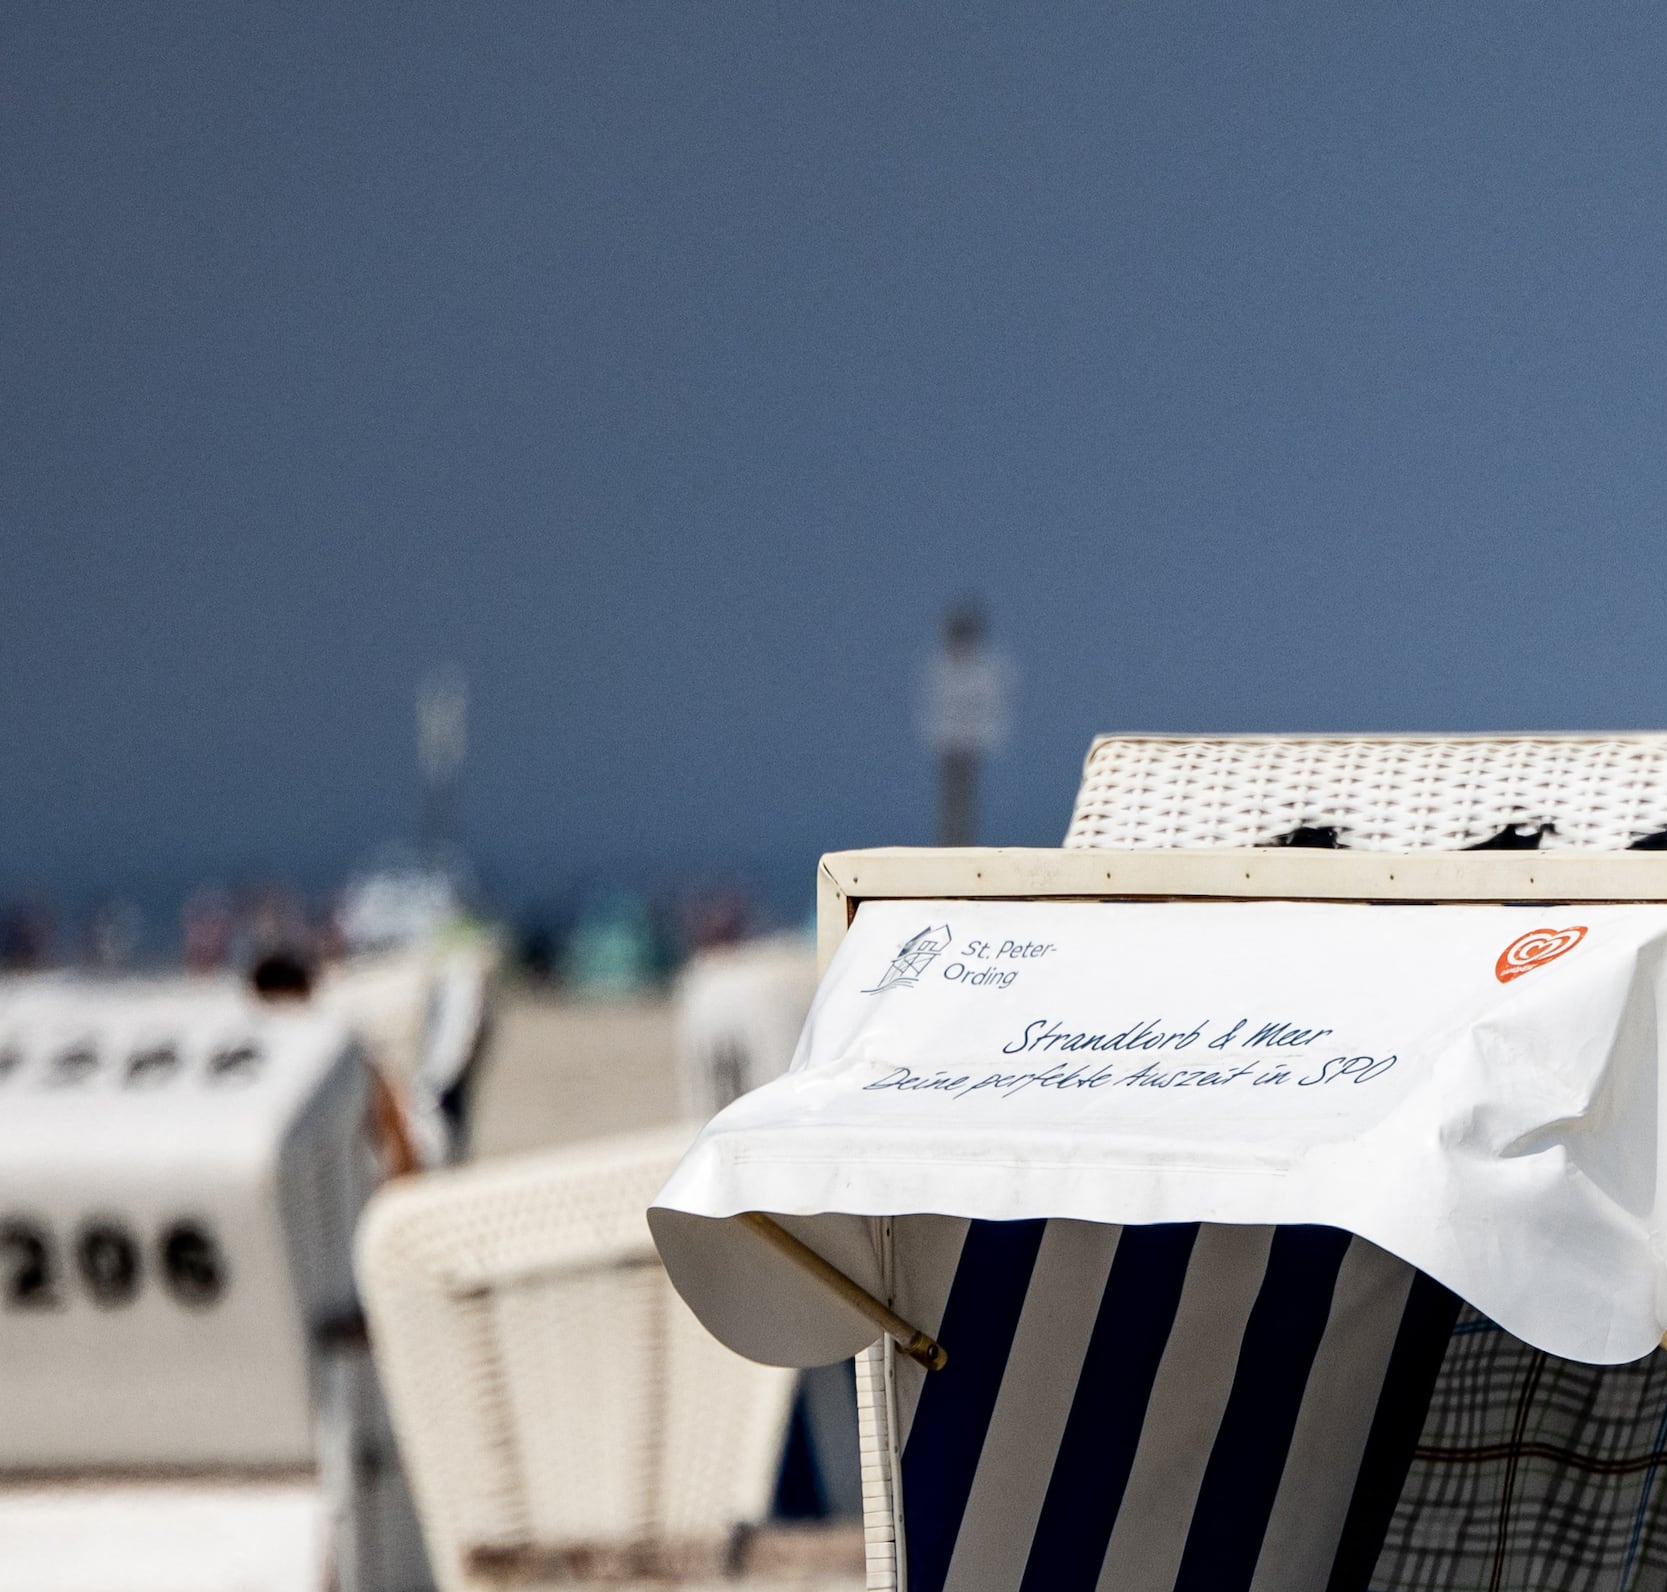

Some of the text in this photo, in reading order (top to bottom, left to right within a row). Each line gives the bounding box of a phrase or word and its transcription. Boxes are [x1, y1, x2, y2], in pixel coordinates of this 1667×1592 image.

[960, 940, 1057, 960] St. Peter-
[943, 962, 1019, 989] Ording
[1002, 1018, 1333, 1054] Strandkorb & Meer
[862, 1055, 1398, 1099] Deine perfekte Auszeit in SPO
